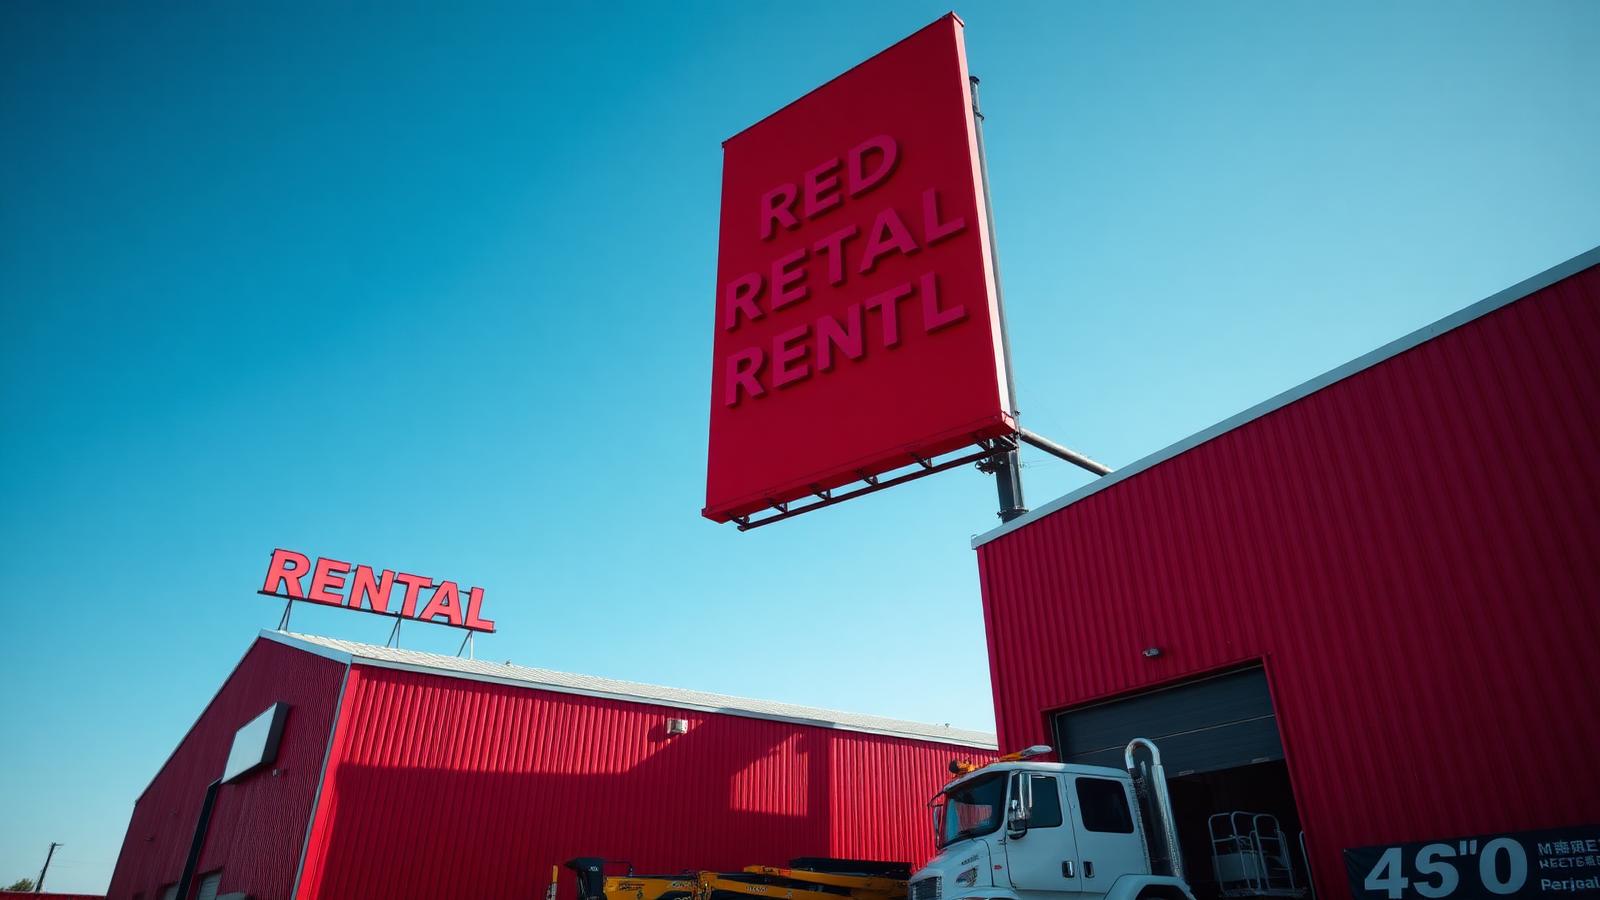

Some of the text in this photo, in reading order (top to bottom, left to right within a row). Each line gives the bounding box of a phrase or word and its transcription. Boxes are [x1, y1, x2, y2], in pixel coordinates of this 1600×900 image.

[760, 134, 898, 241] RED
[724, 187, 966, 331] RETAL
[724, 271, 967, 407] RENTL
[262, 548, 495, 632] RENTAL
